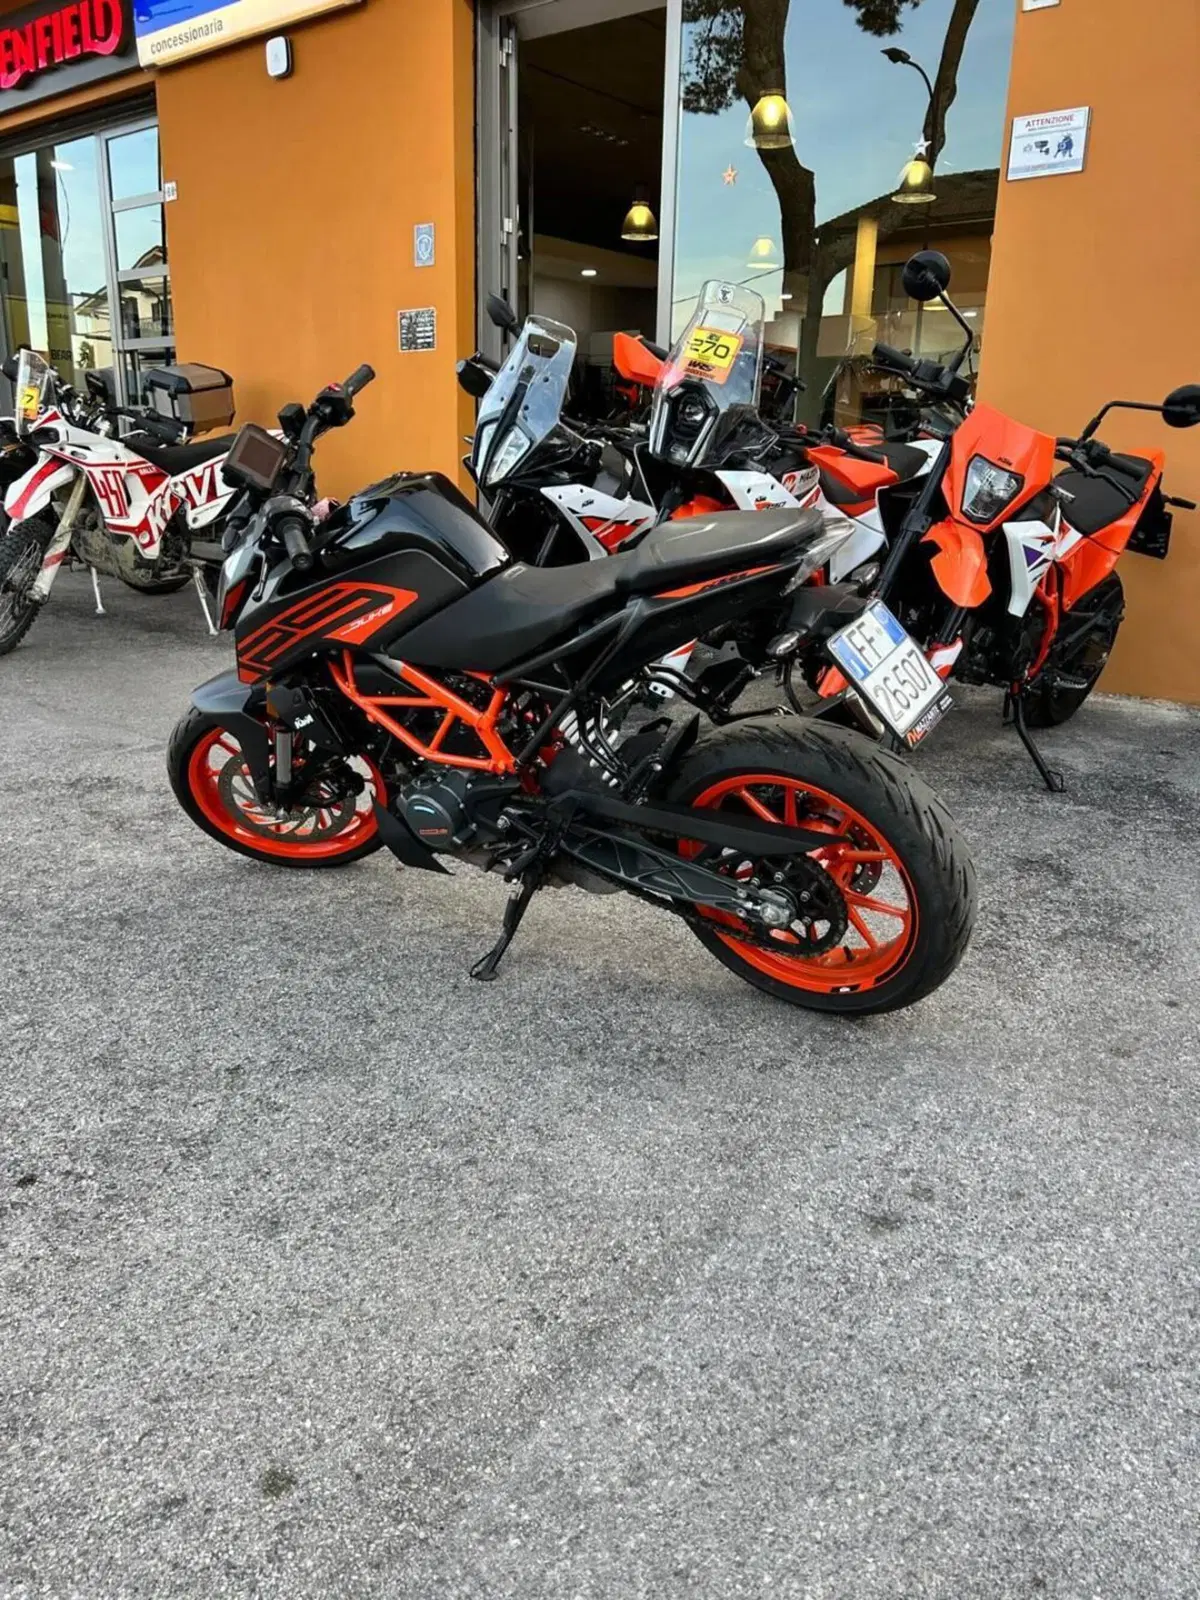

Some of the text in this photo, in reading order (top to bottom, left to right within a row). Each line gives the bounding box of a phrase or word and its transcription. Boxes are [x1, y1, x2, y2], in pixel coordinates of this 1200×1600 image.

[0, 0, 123, 89] ENFIELD
[150, 18, 224, 55] concessionaria
[1025, 114, 1074, 128] ATTENZIONE
[690, 338, 730, 359] 270
[88, 470, 130, 516] 450
[581, 499, 595, 508] KTM
[346, 602, 394, 632] DUKE
[845, 621, 882, 668] FF
[873, 649, 932, 722] 26507
